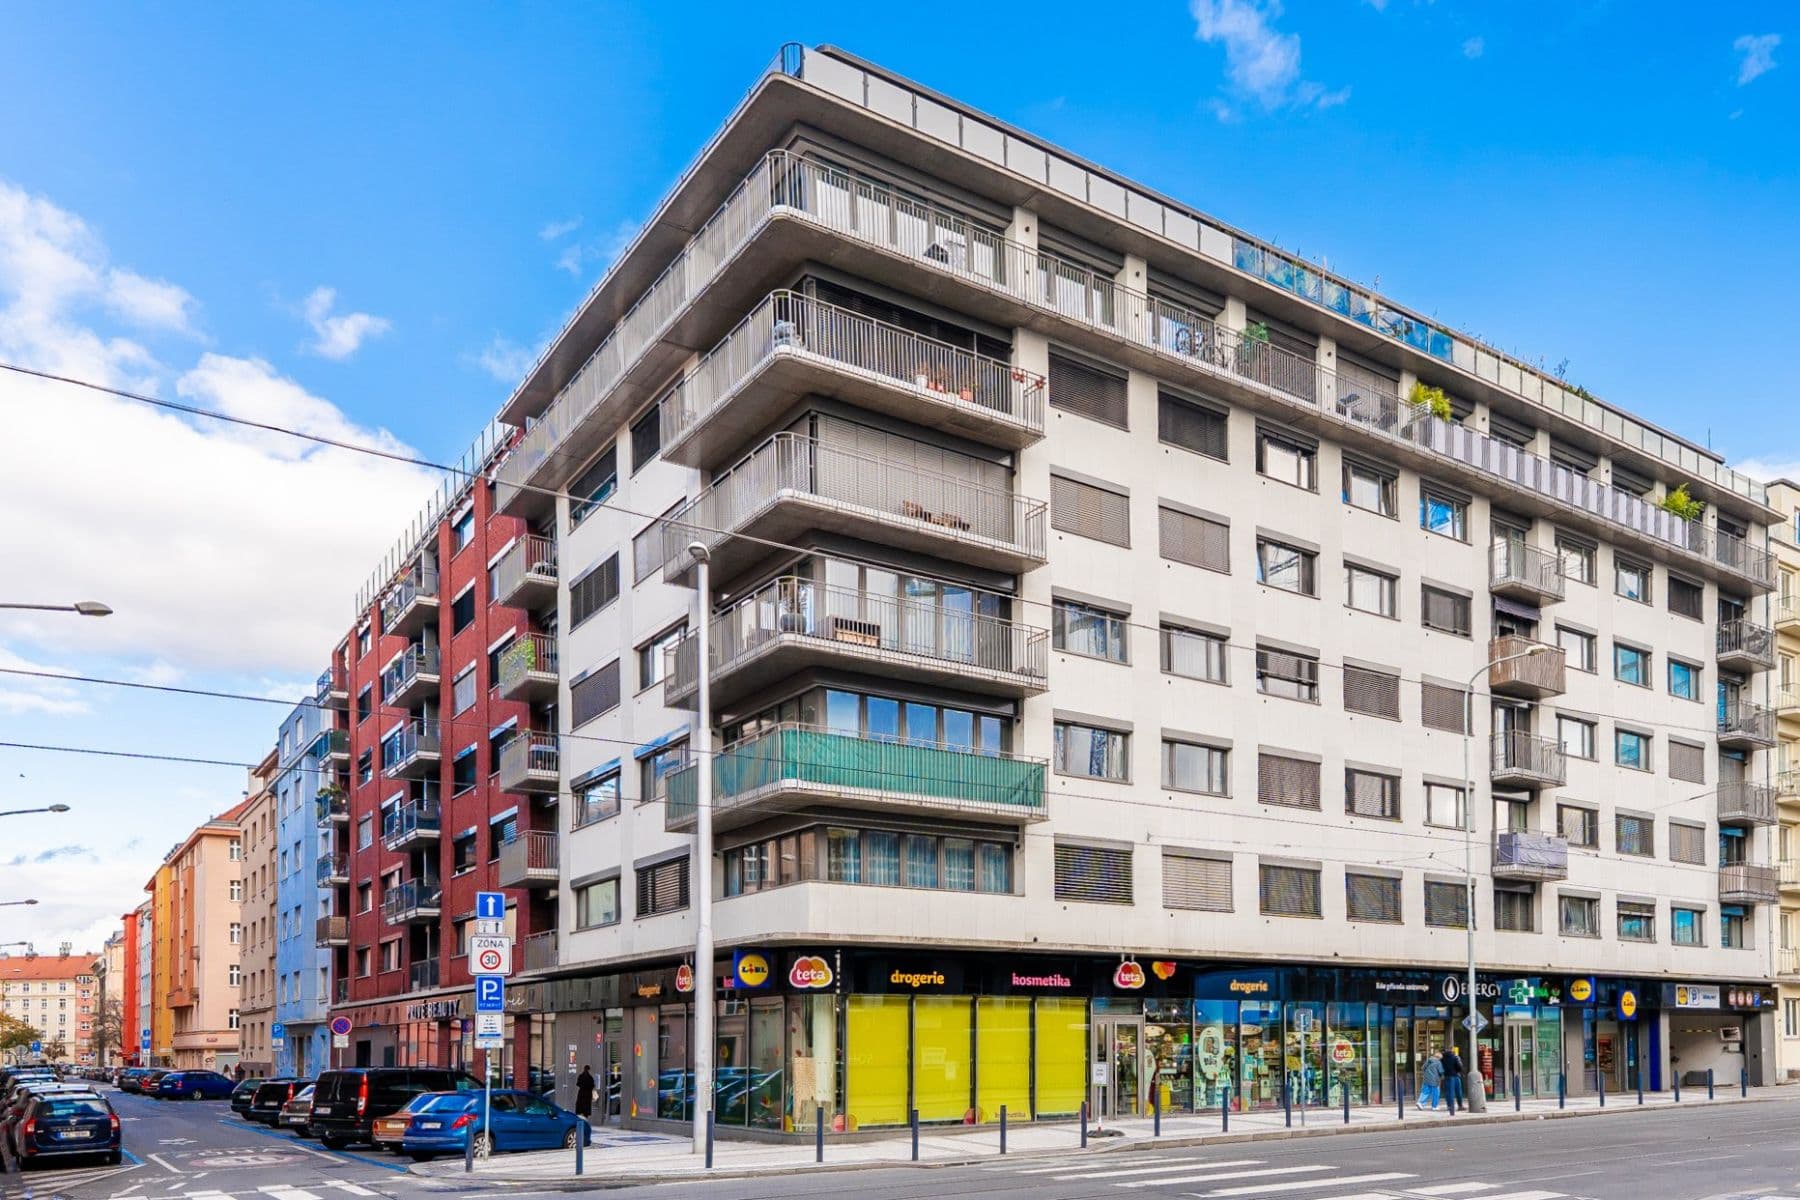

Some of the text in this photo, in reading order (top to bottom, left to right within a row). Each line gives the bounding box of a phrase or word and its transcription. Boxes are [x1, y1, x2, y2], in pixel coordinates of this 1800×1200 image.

[477, 939, 504, 948] ZONA
[484, 955, 498, 965] 30
[796, 968, 826, 981] teta
[890, 970, 945, 987] drogerie
[1012, 972, 1072, 987] kosmetika
[1121, 972, 1140, 982] teta
[482, 980, 498, 1001] P
[1229, 979, 1268, 994] drogerie
[1461, 982, 1502, 998] EERGY
